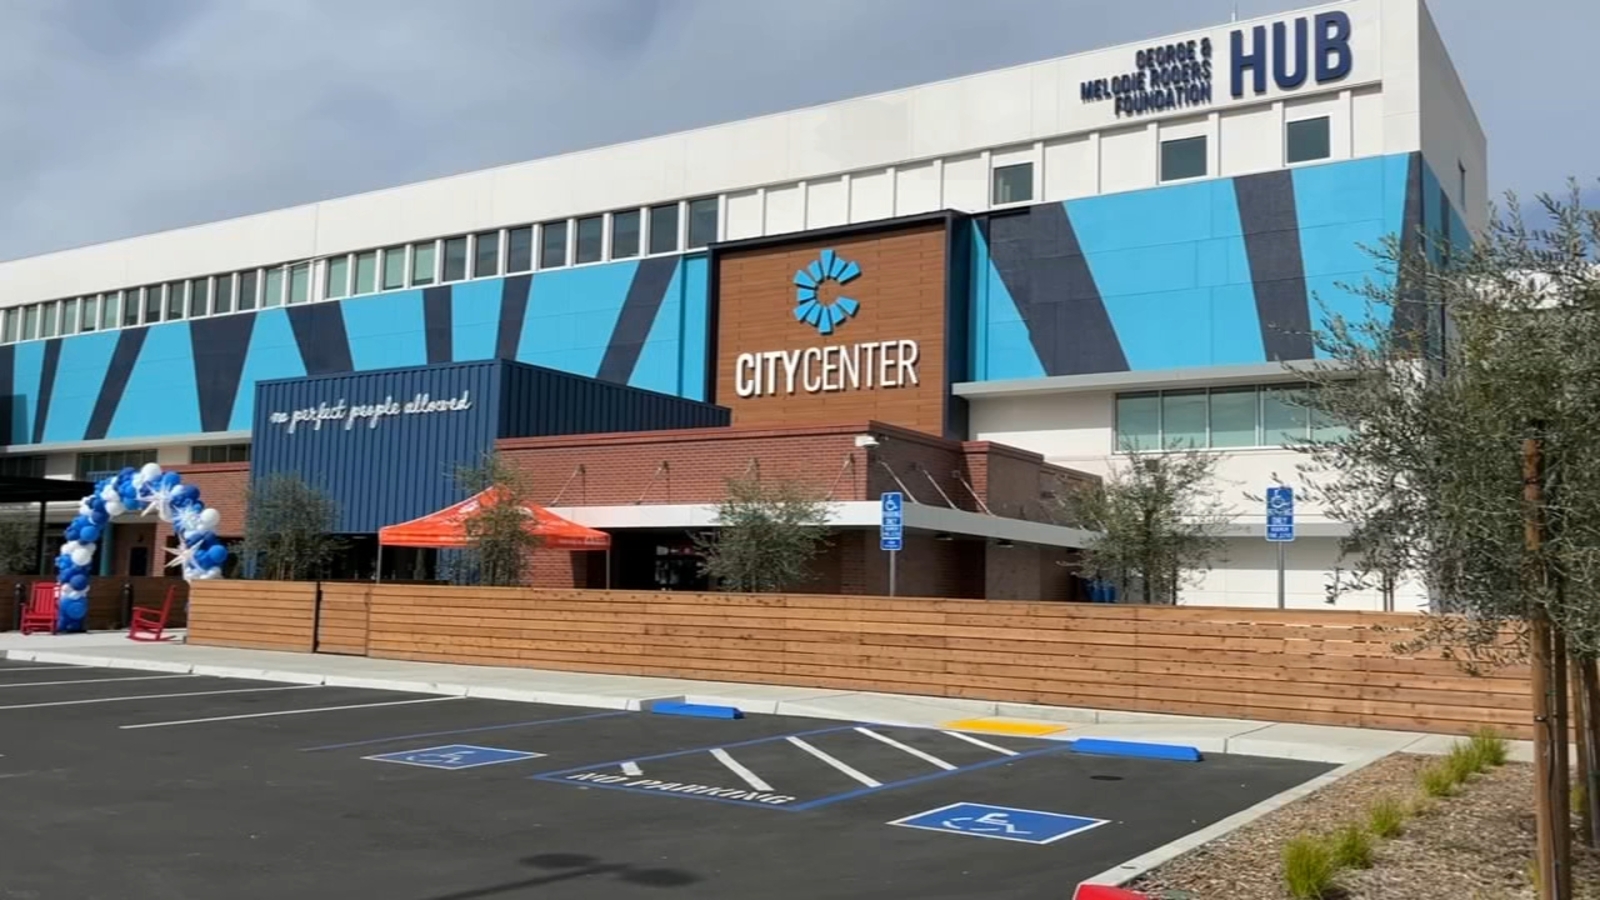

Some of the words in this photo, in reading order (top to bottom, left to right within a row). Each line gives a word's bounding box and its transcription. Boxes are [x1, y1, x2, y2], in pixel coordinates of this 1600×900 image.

[1136, 40, 1197, 70] GEORGE
[1230, 10, 1352, 98] HUB
[1080, 69, 1146, 103] MELODIE
[1149, 60, 1212, 91] ROGERS
[1114, 83, 1212, 117] FOUNDATION
[735, 339, 919, 398] CITYCENTER
[269, 411, 288, 424] no
[288, 399, 347, 434] perfect
[345, 396, 400, 430] people
[404, 390, 473, 414] allowed
[566, 772, 629, 784] NO
[625, 779, 796, 804] PARKING
